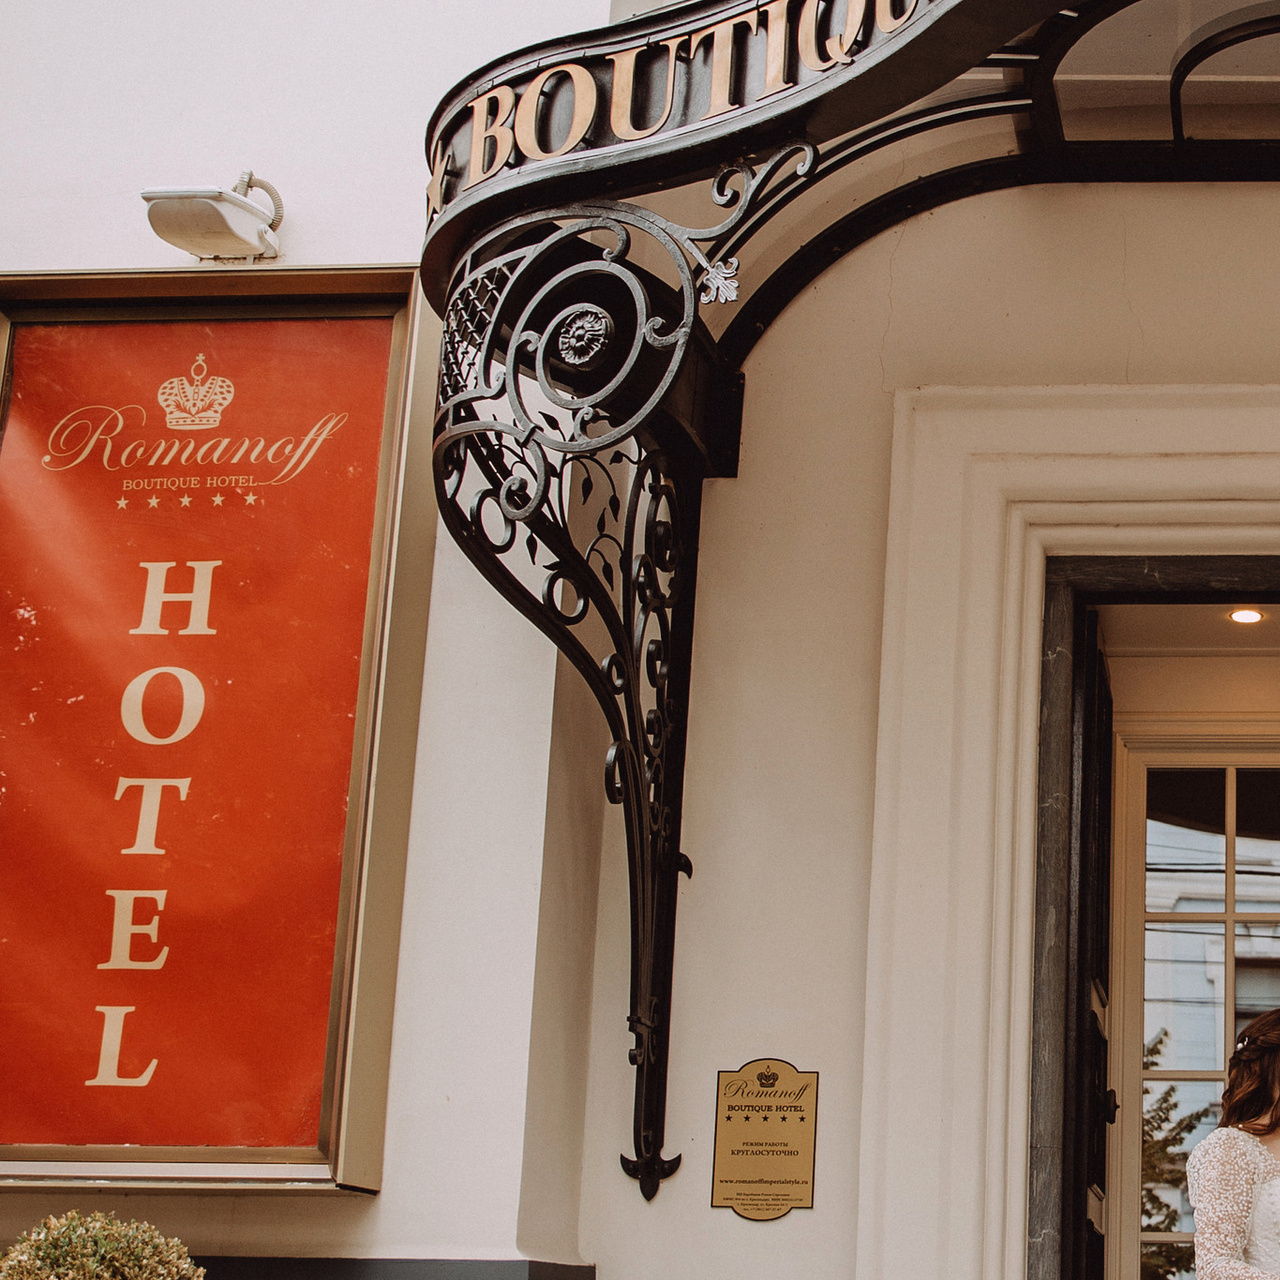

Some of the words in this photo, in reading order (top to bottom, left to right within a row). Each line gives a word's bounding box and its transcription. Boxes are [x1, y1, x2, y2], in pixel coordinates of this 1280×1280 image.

[41, 404, 349, 485] Romanoff
[122, 476, 201, 491] BOUTIQUE
[206, 475, 259, 488] HOTEL
[84, 560, 223, 1088] HOTEL
[723, 1078, 811, 1103] Romanoff
[727, 1104, 773, 1113] BOUTIQUE
[775, 1105, 805, 1113] HOTEL
[731, 1149, 799, 1157] КРУГЛОСУТОЧНО
